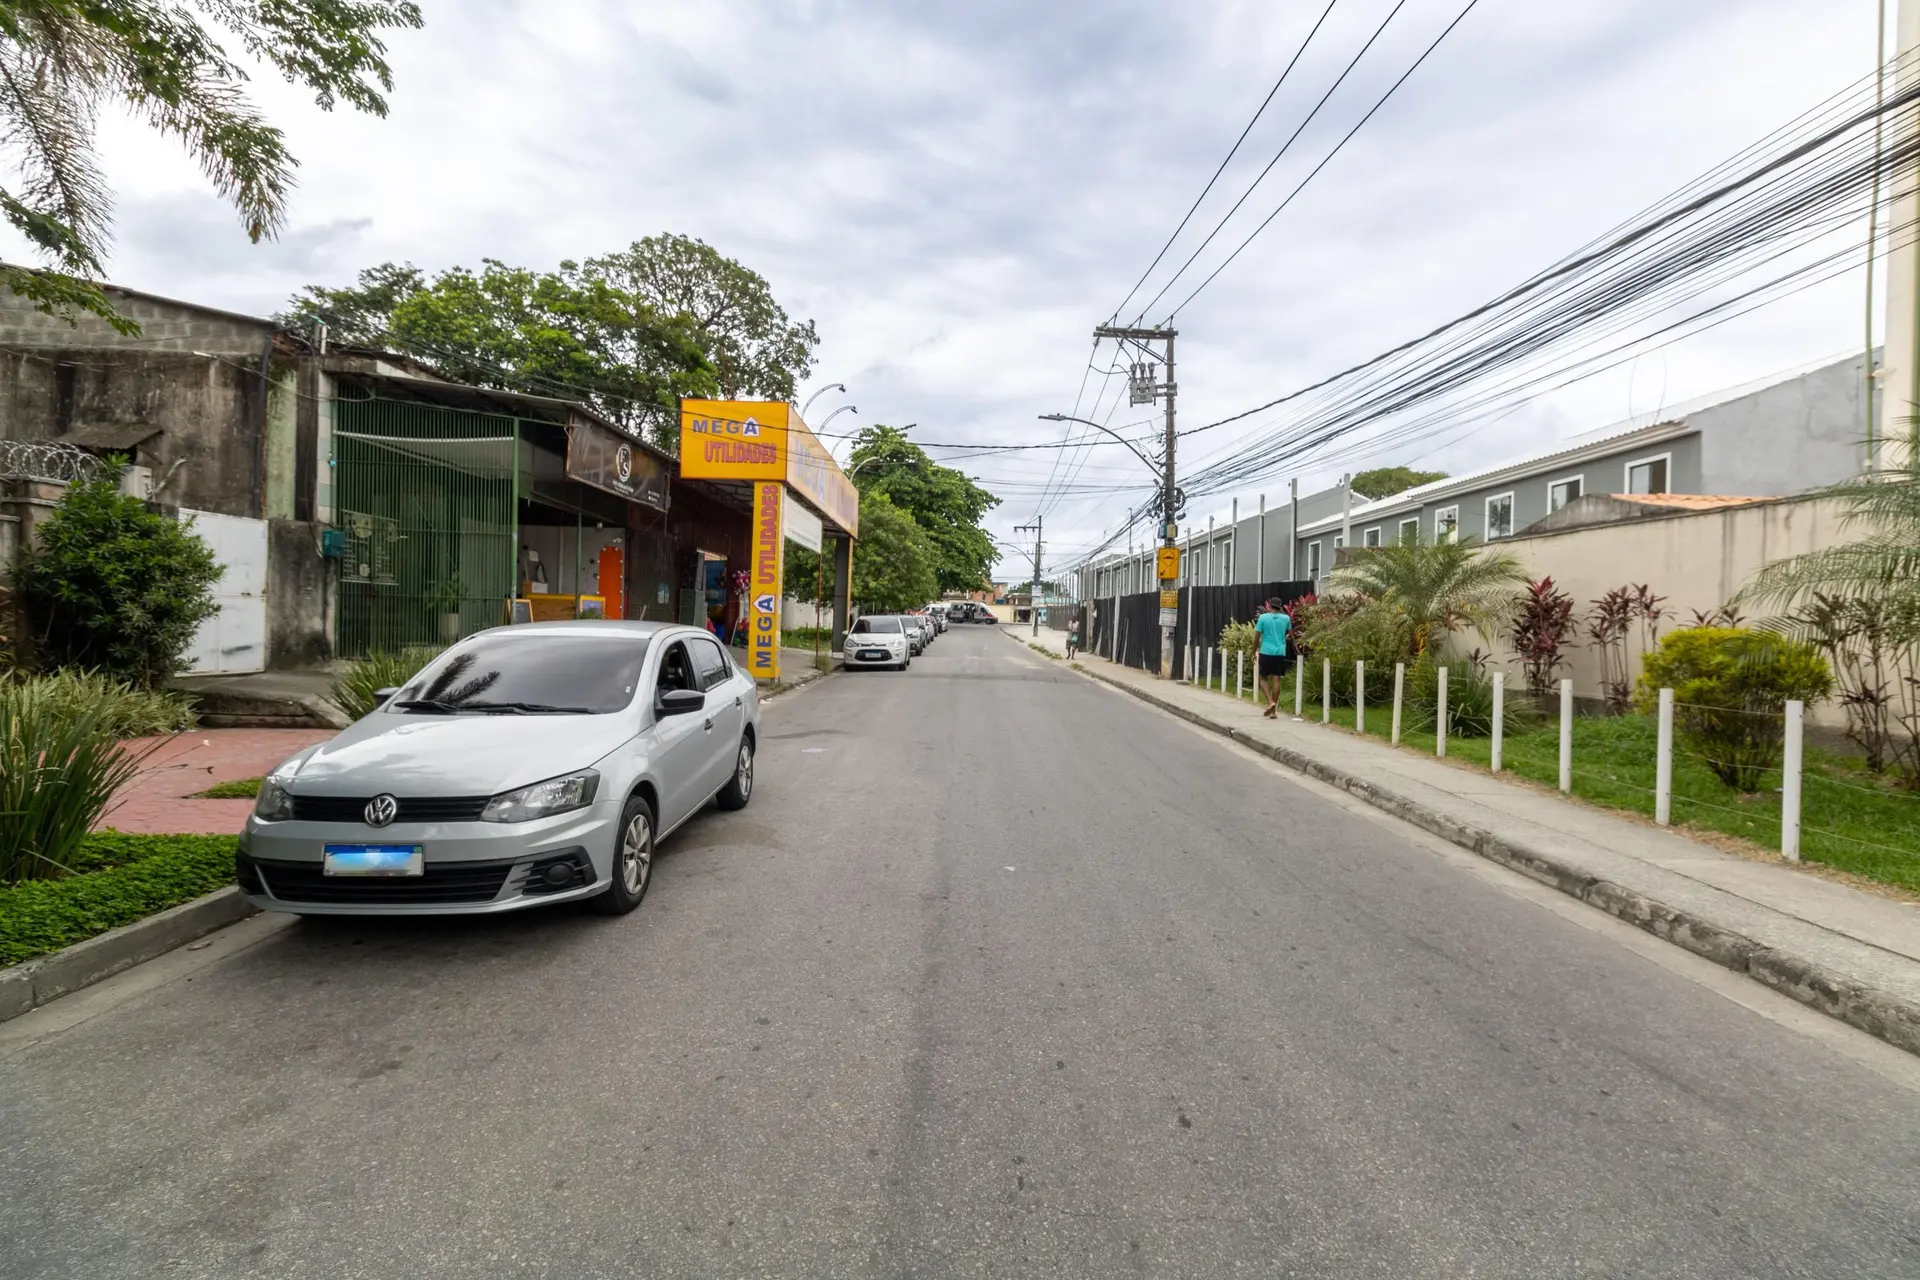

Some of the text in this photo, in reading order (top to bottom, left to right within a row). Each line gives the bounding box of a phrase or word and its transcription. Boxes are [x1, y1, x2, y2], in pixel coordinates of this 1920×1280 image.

[692, 419, 758, 435] MEGA
[704, 441, 776, 464] UTILIDADES
[756, 485, 778, 668] MEGA UTILIDADES
